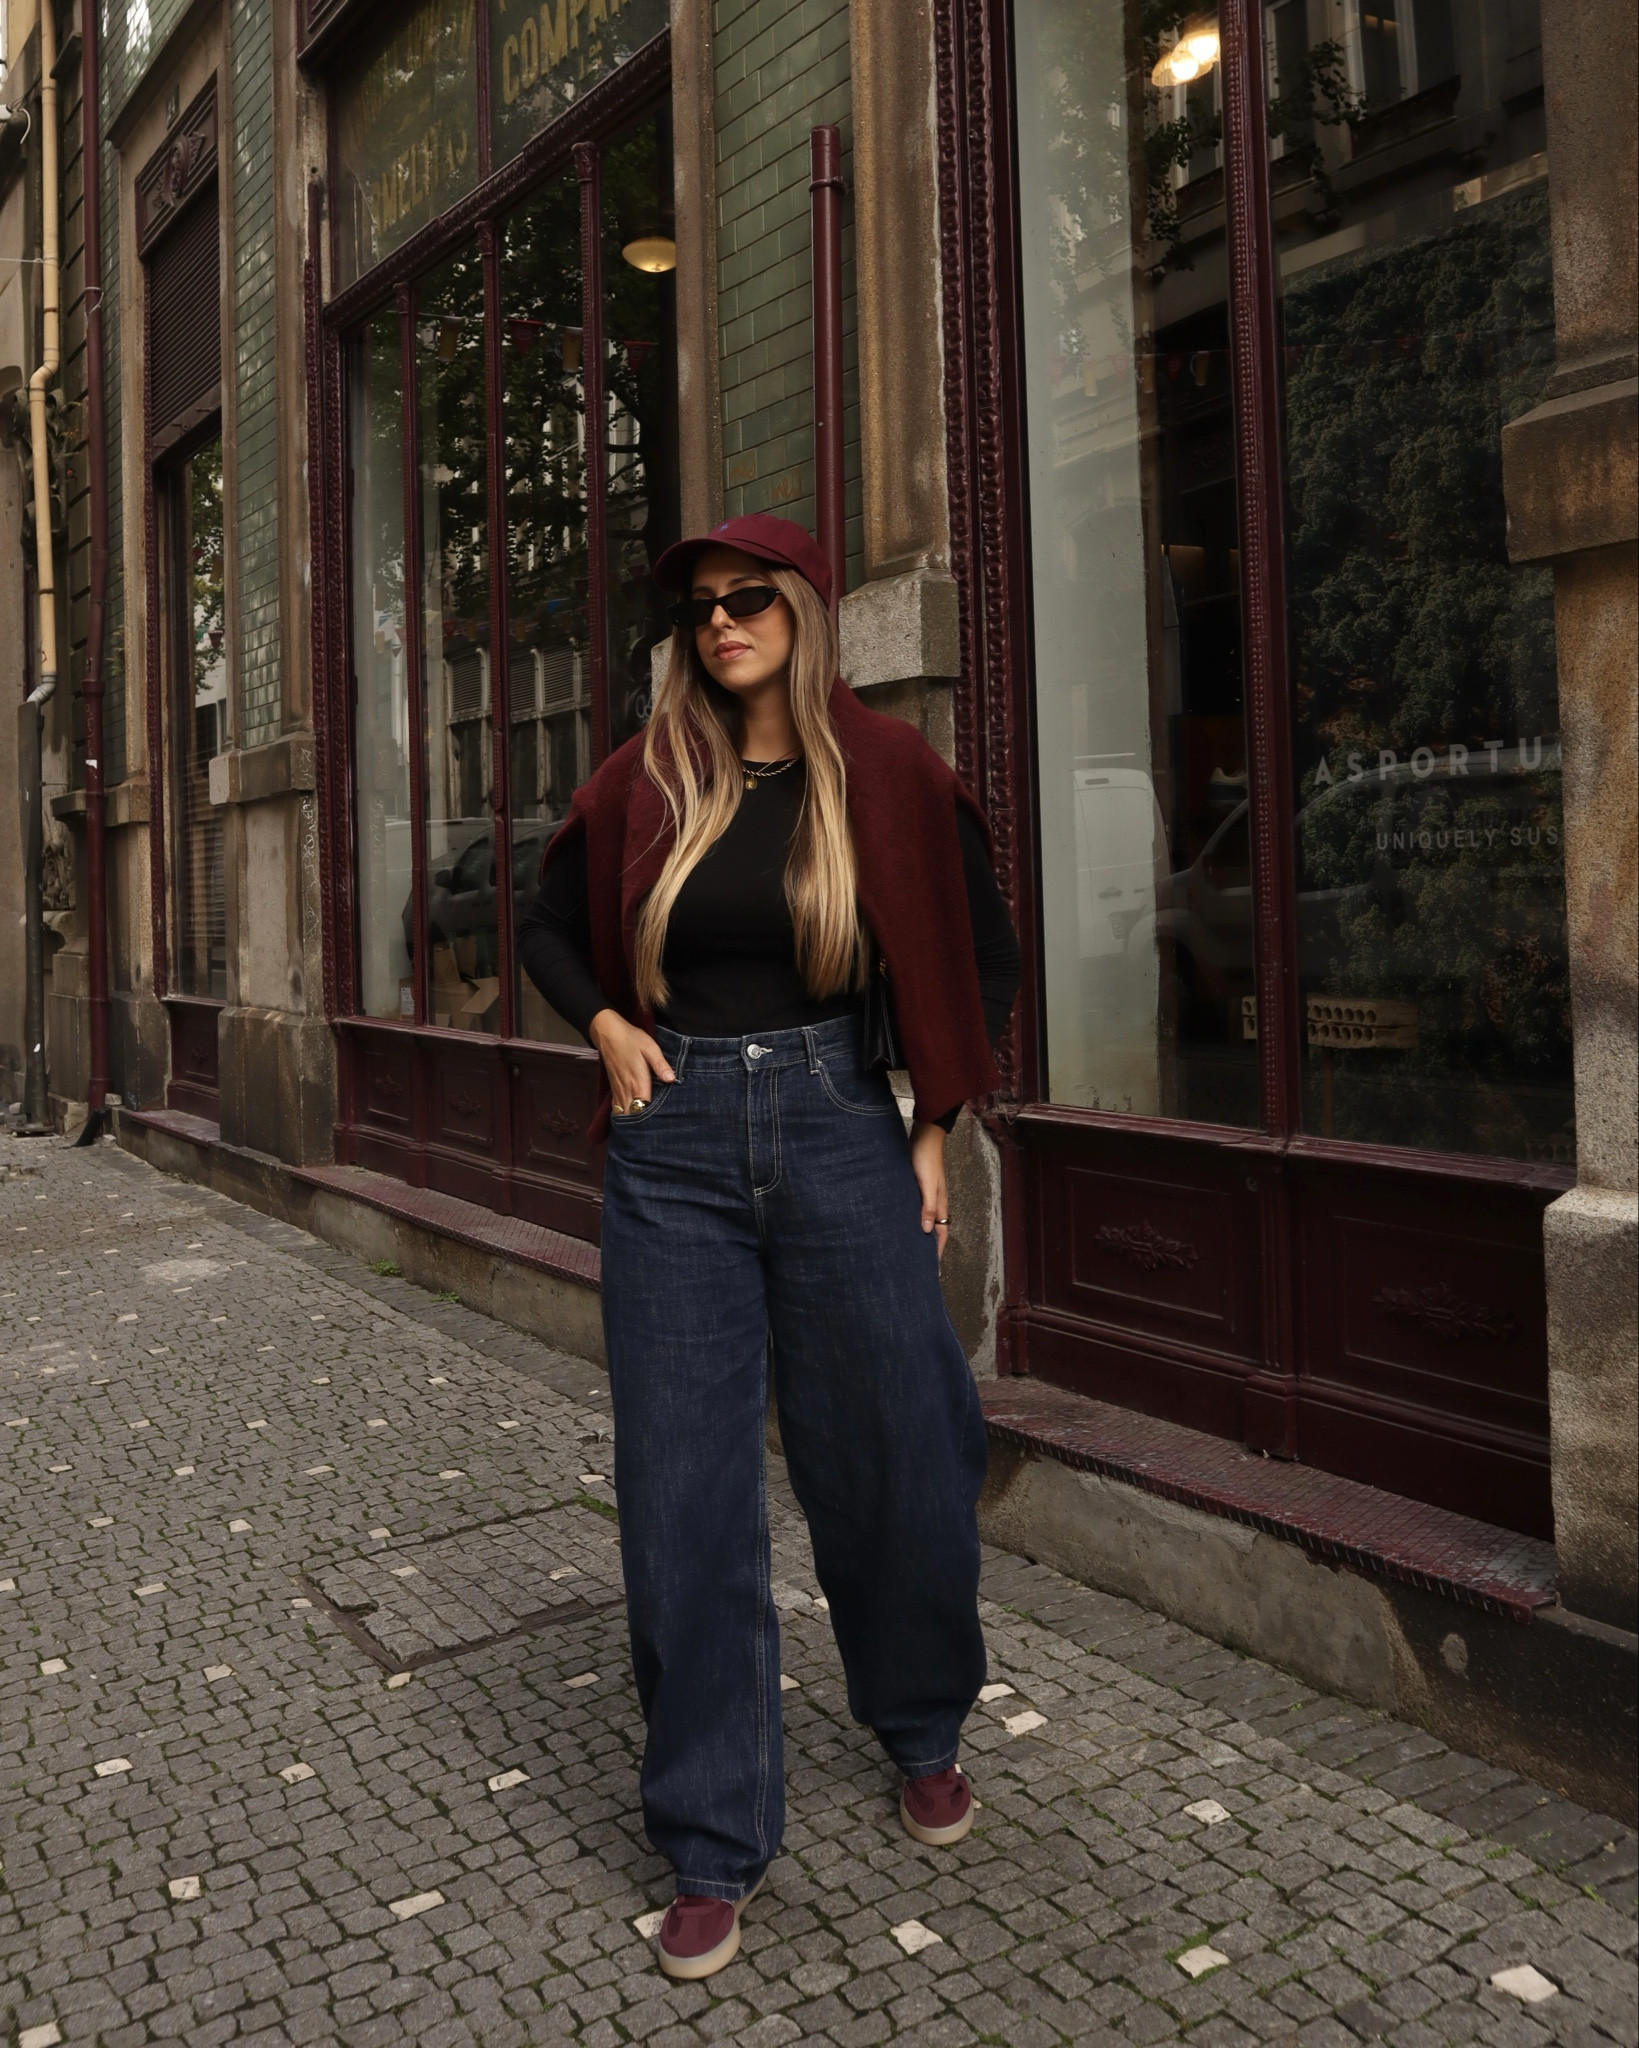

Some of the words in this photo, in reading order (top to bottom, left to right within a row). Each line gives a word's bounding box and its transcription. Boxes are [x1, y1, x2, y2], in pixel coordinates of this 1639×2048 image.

[502, 0, 631, 105] COMP
[1314, 736, 1563, 785] ASPORTU
[1376, 829, 1498, 851] UNIQUELY
[1510, 826, 1559, 847] SUS
